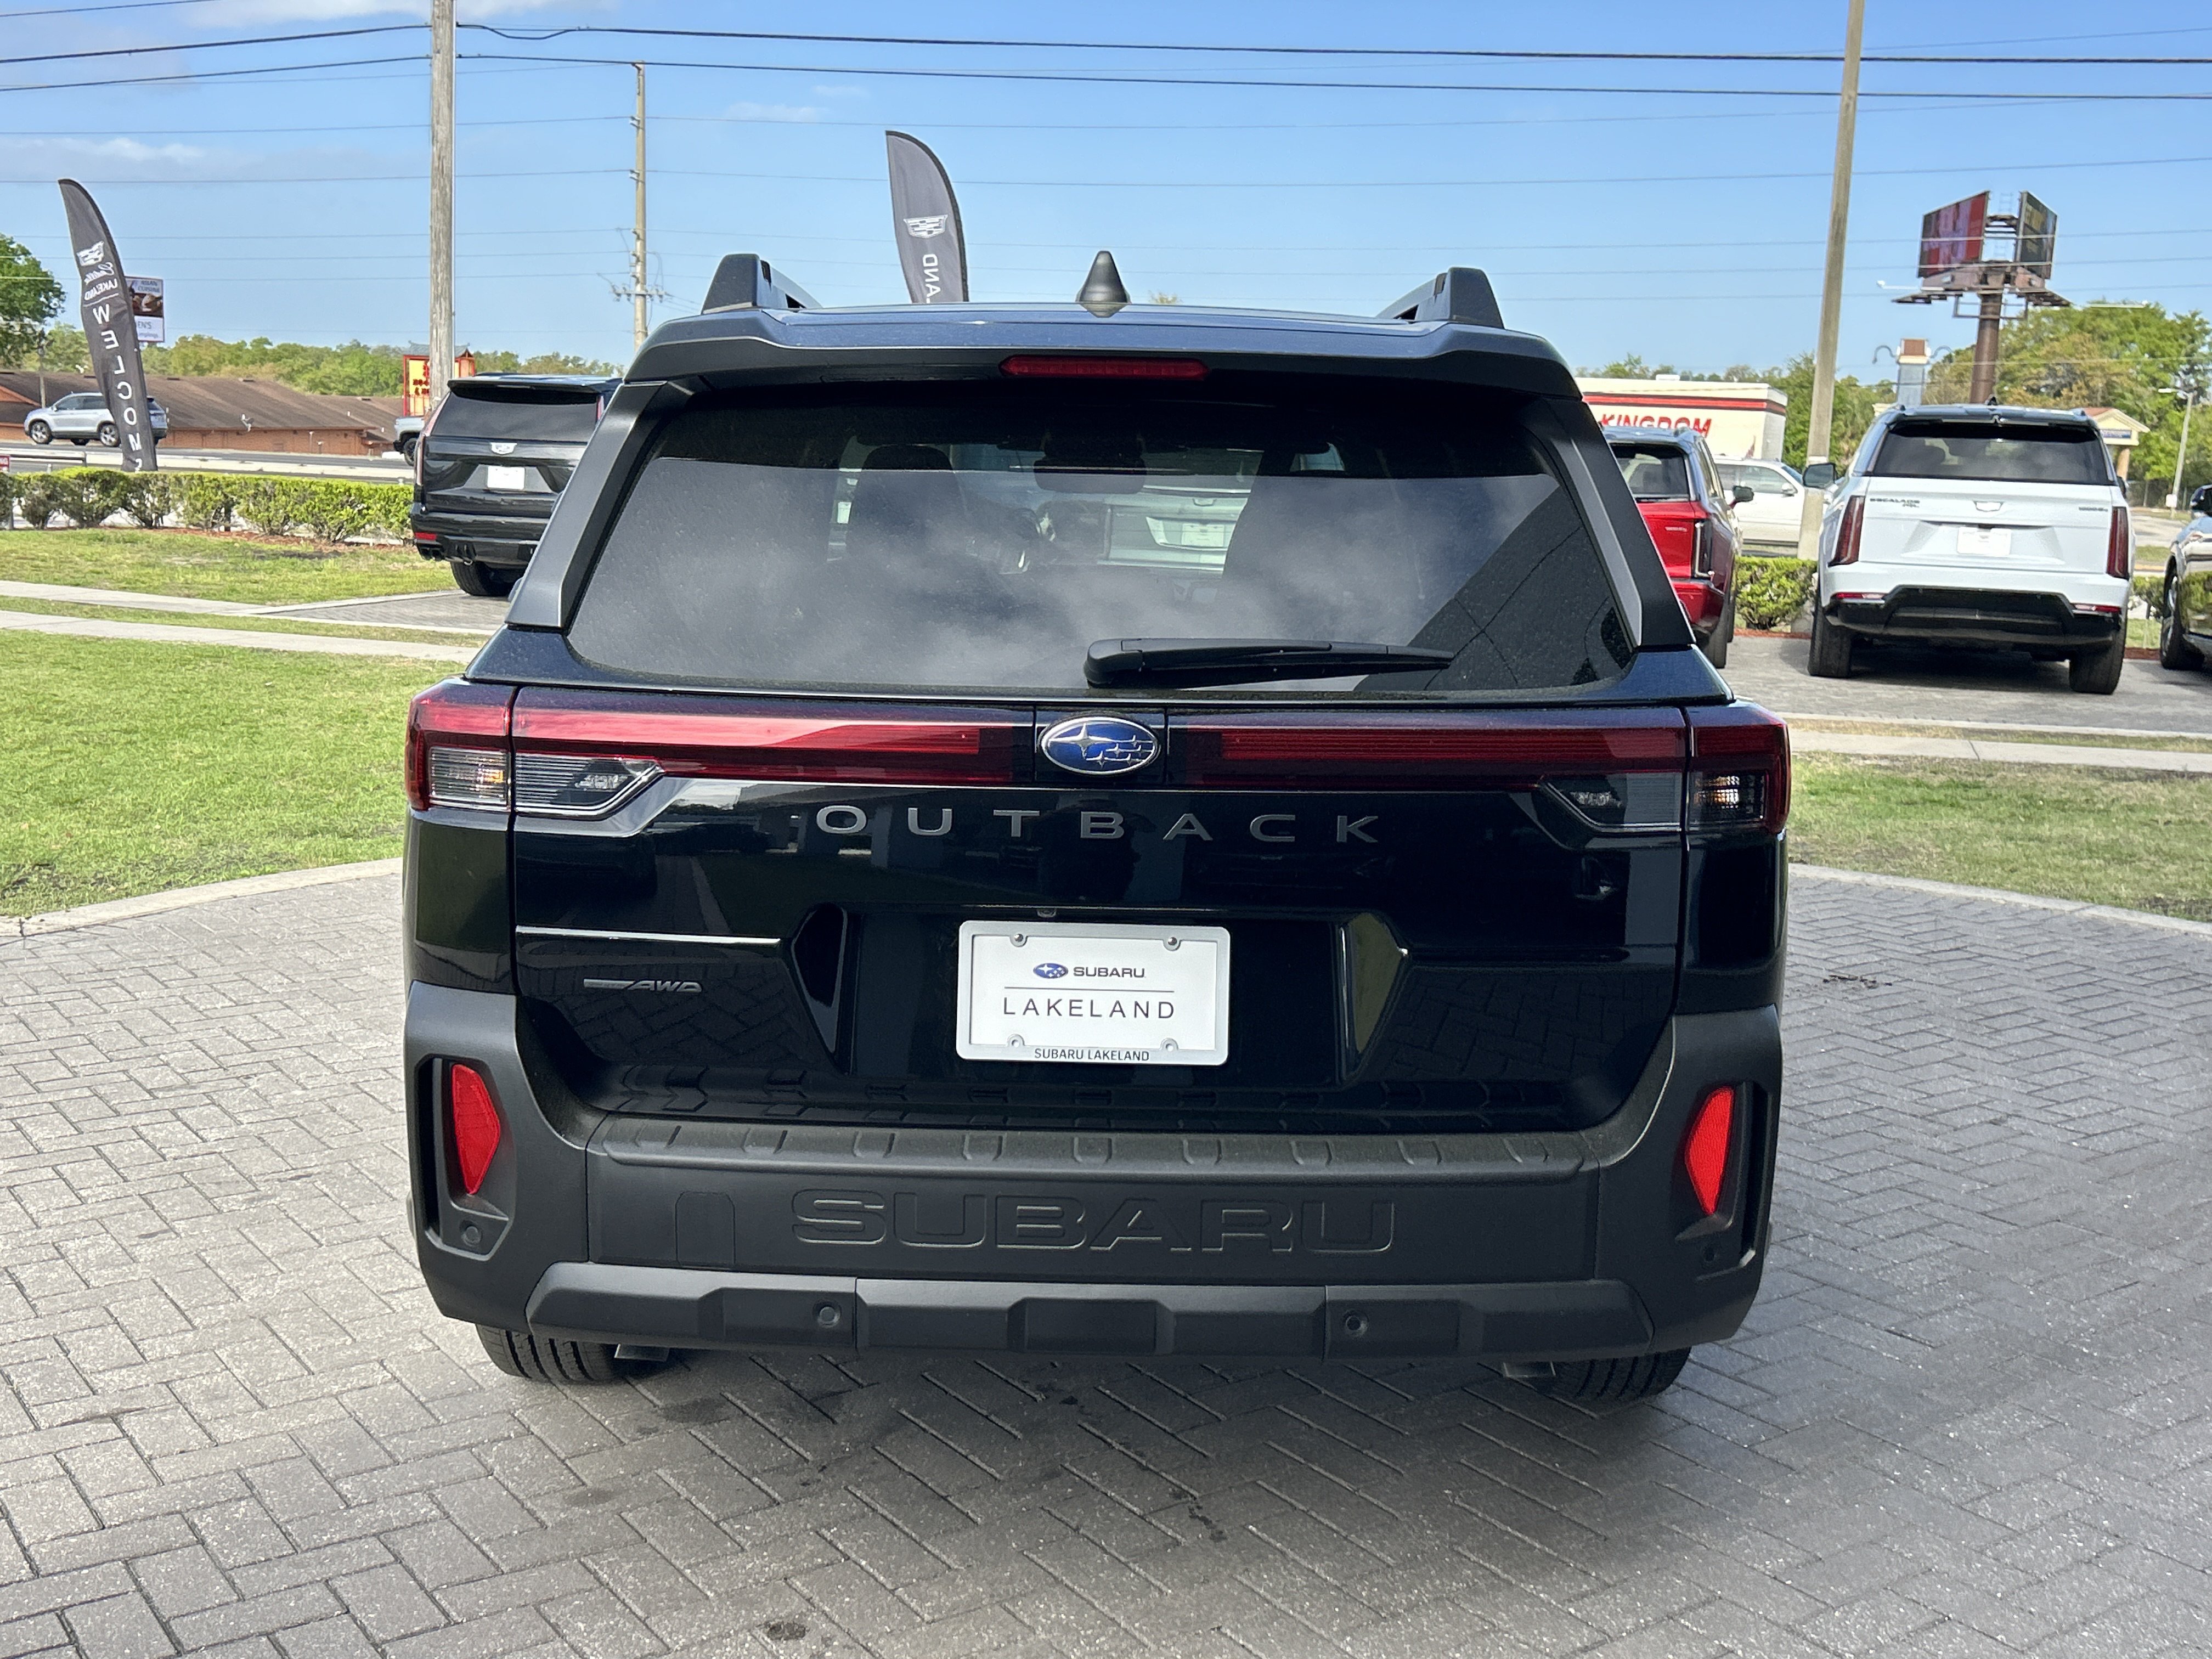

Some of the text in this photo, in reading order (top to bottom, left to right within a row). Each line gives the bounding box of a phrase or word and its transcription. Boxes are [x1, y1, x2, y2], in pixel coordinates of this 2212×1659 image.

[816, 805, 1378, 843] OUTBACK
[1073, 967, 1146, 978] SUBARU
[628, 980, 703, 992] AWD
[1003, 997, 1175, 1019] LAKELAND
[1034, 1048, 1149, 1062] SUBARU LAKELAND
[792, 1188, 1394, 1254] SUBARU
